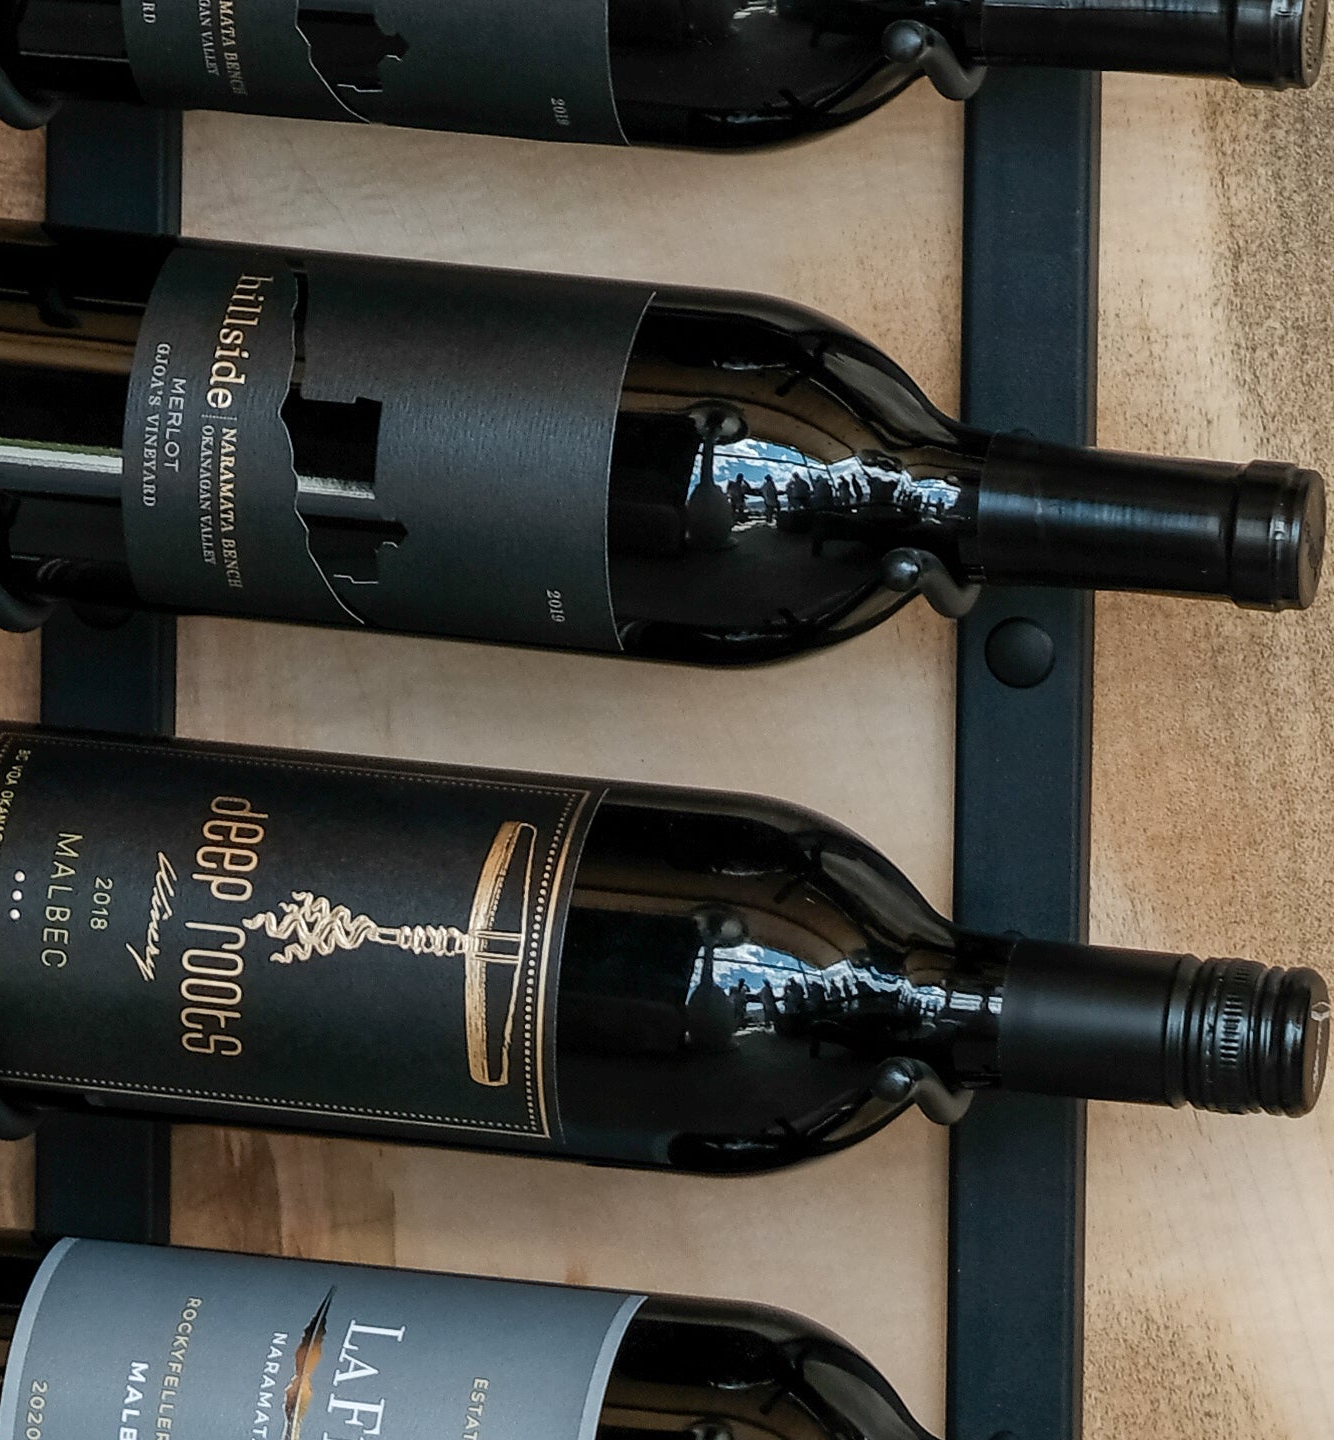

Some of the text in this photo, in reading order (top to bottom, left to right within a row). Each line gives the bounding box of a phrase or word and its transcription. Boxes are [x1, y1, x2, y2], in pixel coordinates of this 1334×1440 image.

[200, 31, 219, 77] VALLEY
[223, 51, 248, 96] BENCH
[206, 273, 274, 410] hillside
[143, 342, 172, 507] GJOA'S VINEYARD
[164, 377, 187, 472] MERLOT
[199, 424, 216, 565] OKANAGAN VALLEY
[219, 427, 243, 589] NARAMATA BENCH
[4, 766, 23, 785] VQA
[41, 831, 84, 970] MALBEC
[89, 876, 113, 931] 2018
[125, 850, 178, 982] Winery
[179, 795, 269, 1057] deep roots
[26, 1380, 49, 1440] 2020
[251, 1331, 288, 1440] NARAMAT
